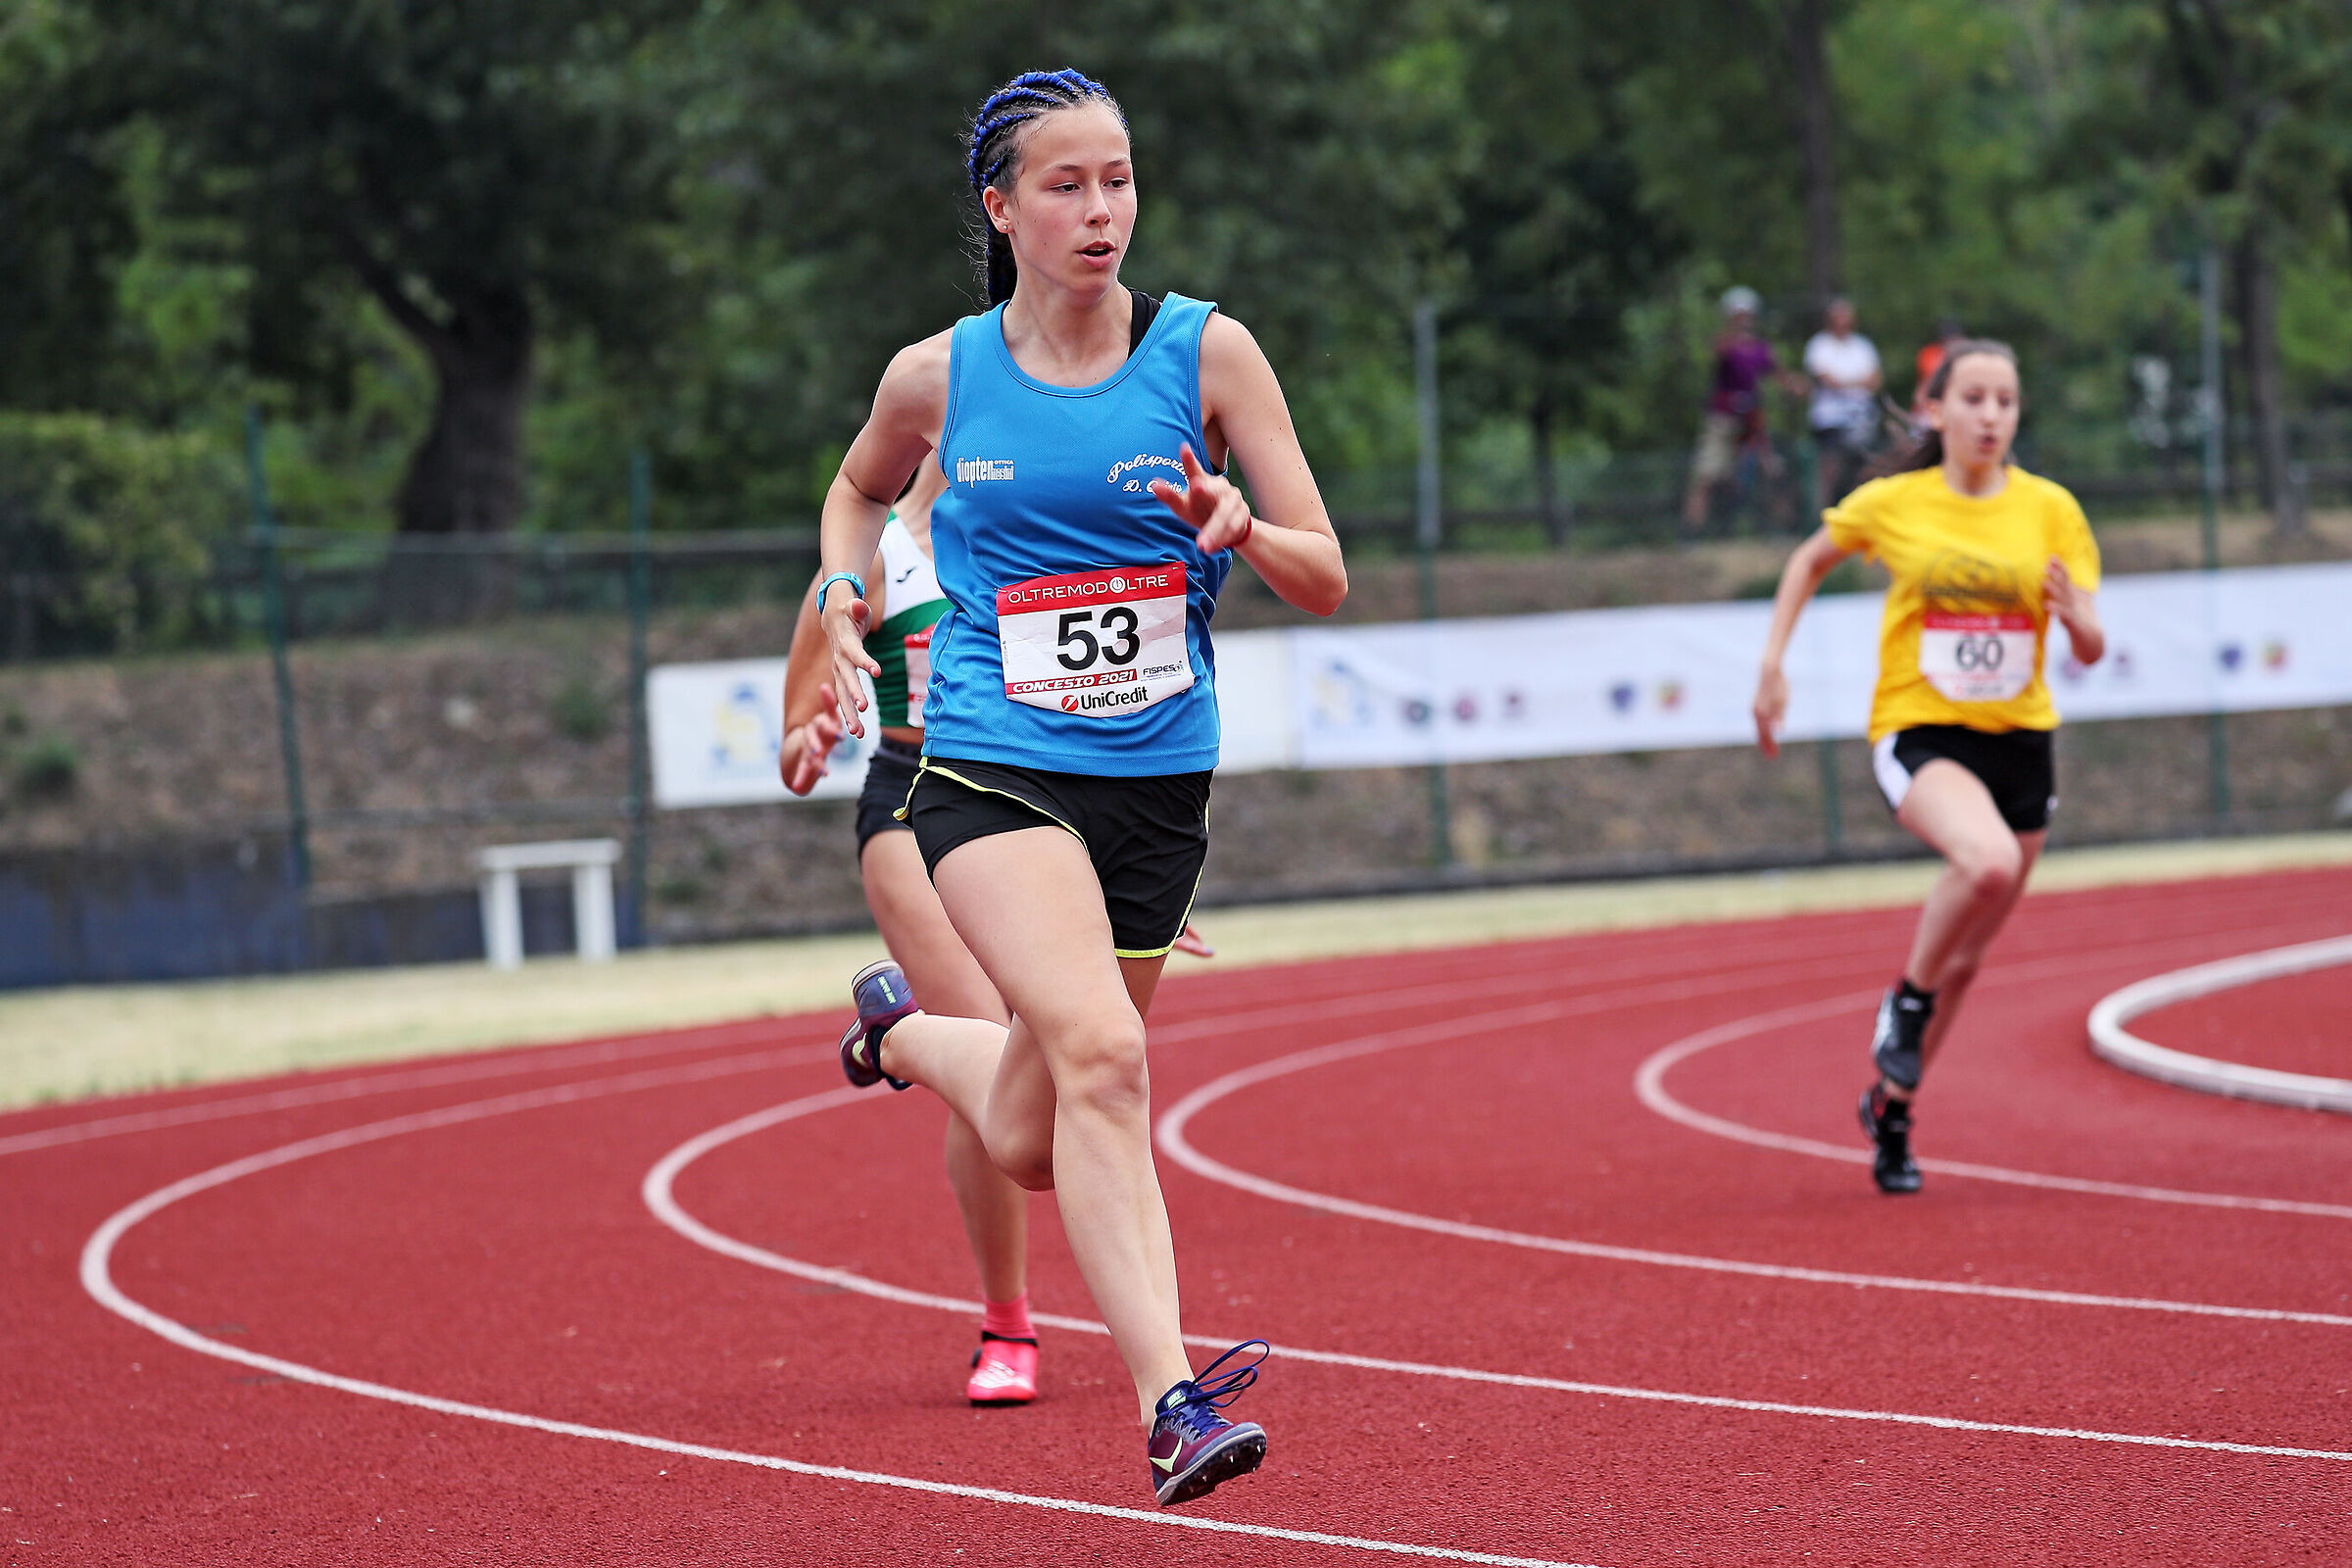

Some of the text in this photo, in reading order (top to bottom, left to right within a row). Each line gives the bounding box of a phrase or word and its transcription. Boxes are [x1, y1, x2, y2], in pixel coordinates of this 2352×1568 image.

[1122, 479, 1143, 492] D.
[1007, 574, 1169, 604] OLTREMODOLTRE
[1056, 607, 1141, 671] 53
[1955, 636, 2004, 671] 60
[1012, 676, 1096, 694] CONCESIO
[1098, 670, 1135, 685] 2021
[1081, 686, 1149, 710] UniCredit
